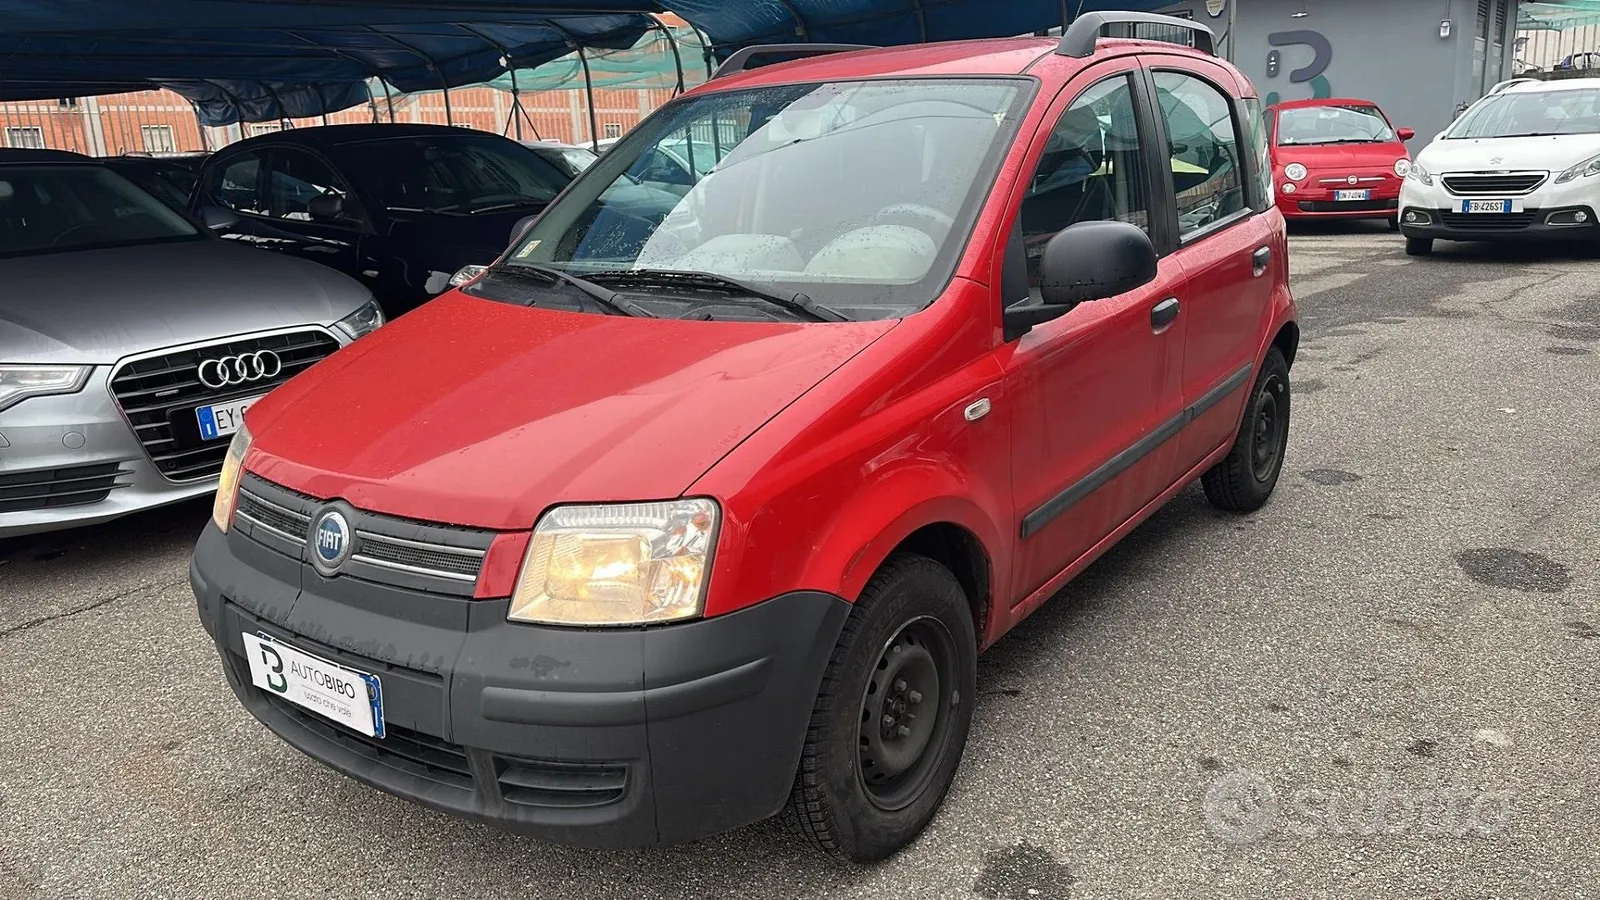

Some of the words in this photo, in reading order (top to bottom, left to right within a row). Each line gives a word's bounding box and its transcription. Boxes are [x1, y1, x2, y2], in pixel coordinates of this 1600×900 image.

[1480, 202, 1504, 211] 426ST
[318, 528, 342, 550] FIAT
[291, 660, 356, 699] AUTOBIBO
[303, 690, 322, 705] usato
[323, 697, 337, 711] che
[337, 704, 352, 718] vale
